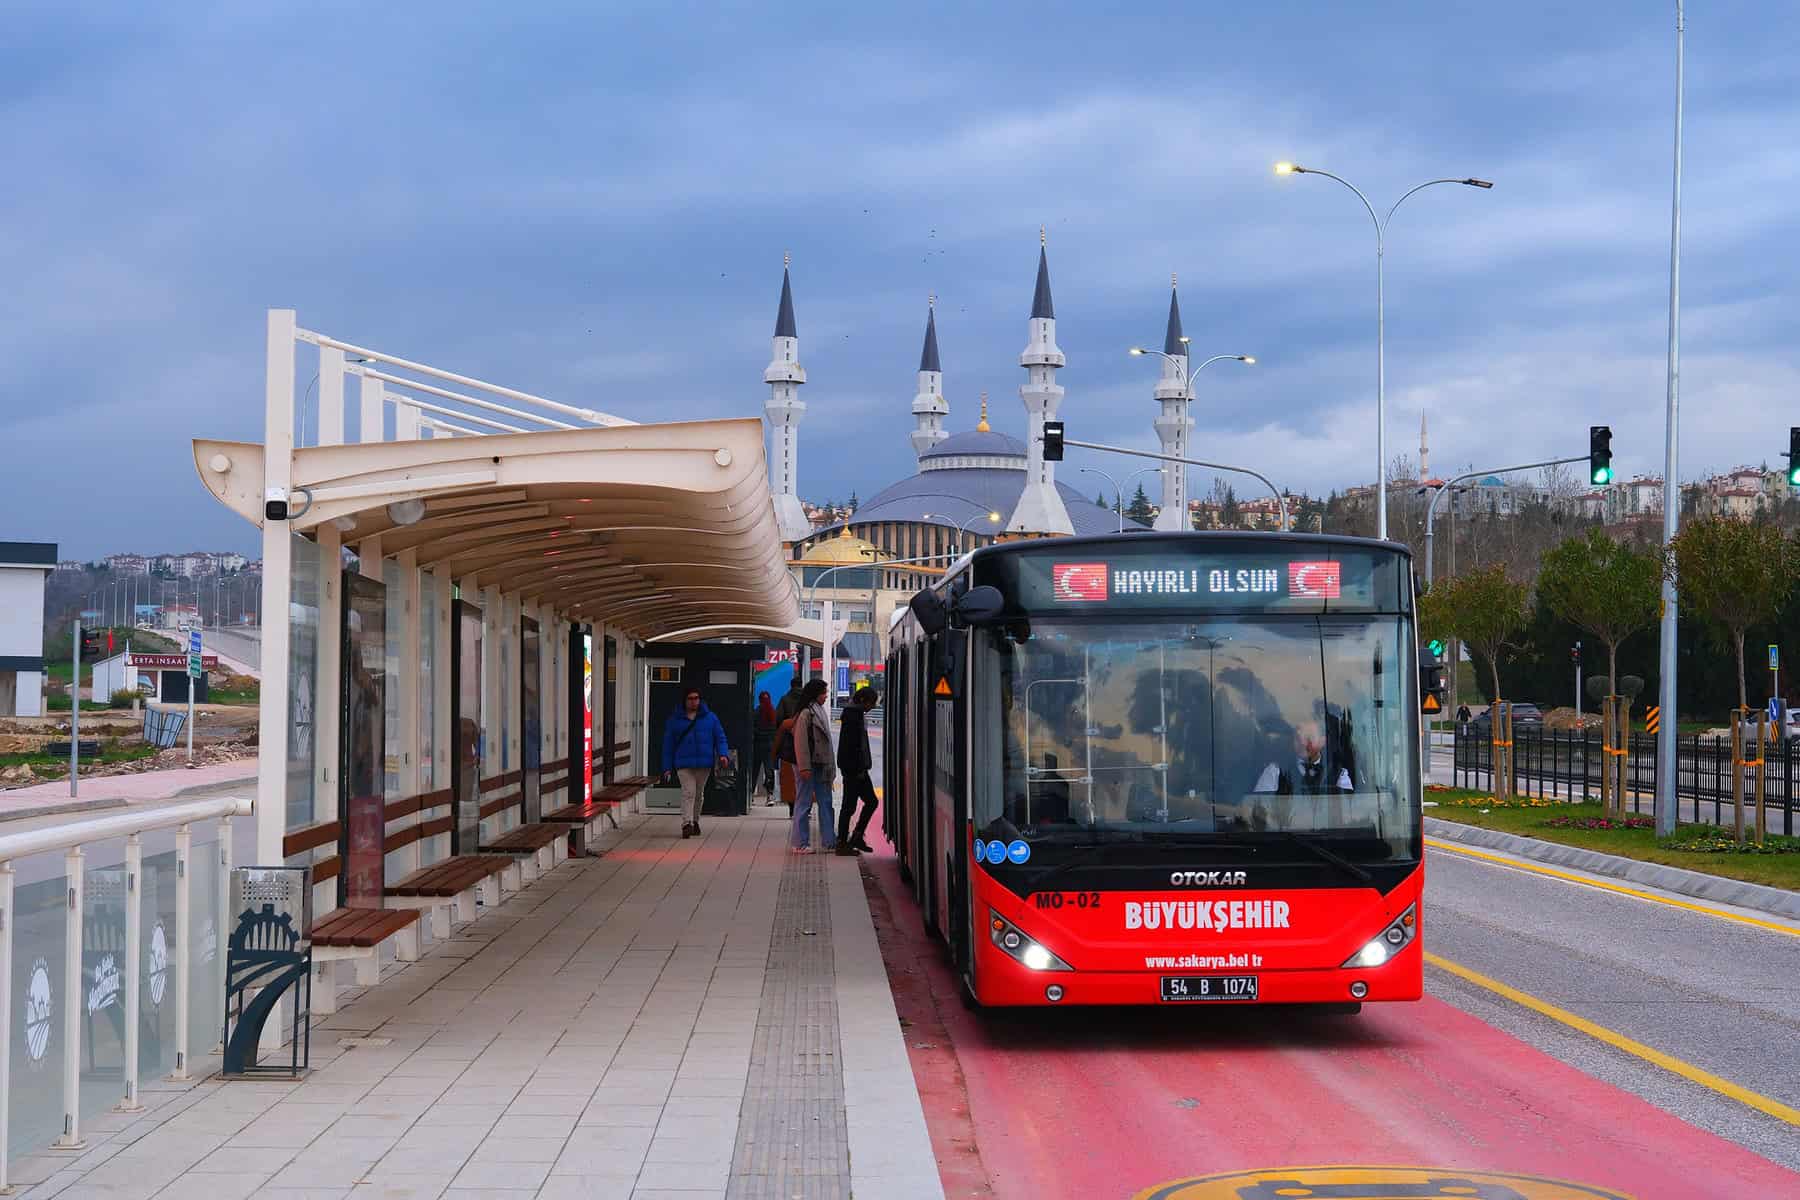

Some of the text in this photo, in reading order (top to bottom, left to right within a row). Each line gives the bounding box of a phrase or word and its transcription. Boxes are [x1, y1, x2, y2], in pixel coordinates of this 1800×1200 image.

[1114, 569, 1279, 593] HAYIRLI OLSUN
[1170, 871, 1247, 886] OTOKAR
[1125, 899, 1291, 933] BÜYÜKŞEHİR
[1171, 978, 1255, 995] 54 B 1074
